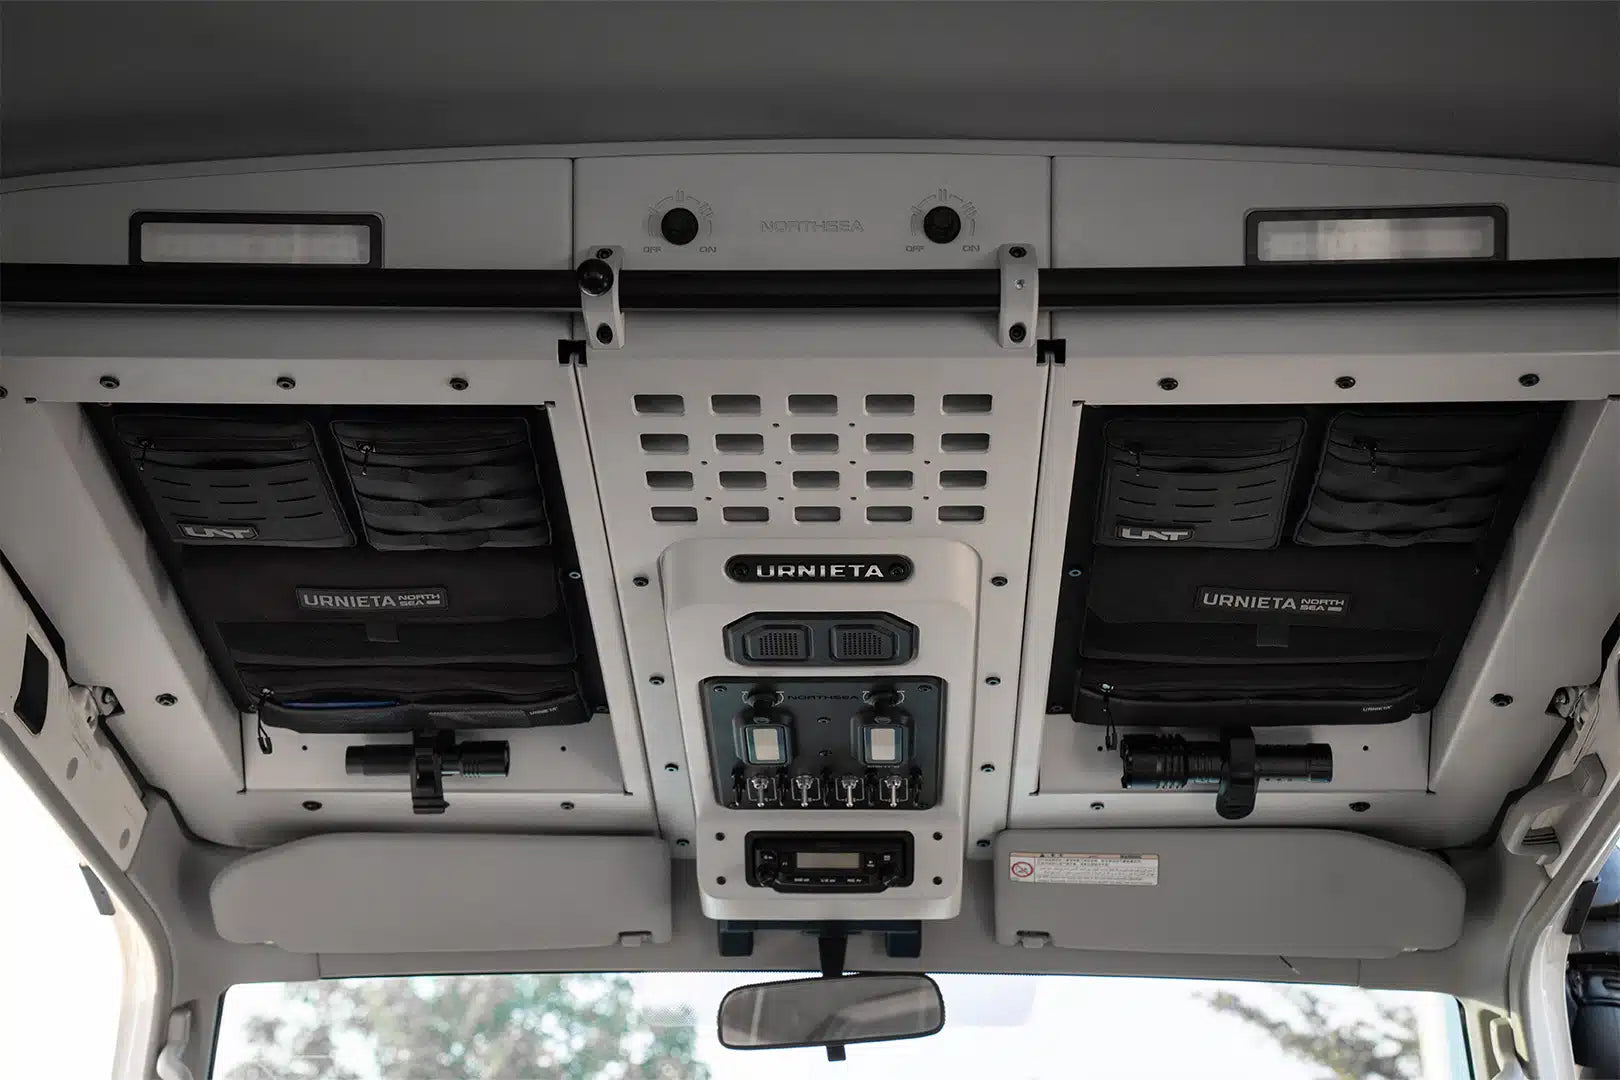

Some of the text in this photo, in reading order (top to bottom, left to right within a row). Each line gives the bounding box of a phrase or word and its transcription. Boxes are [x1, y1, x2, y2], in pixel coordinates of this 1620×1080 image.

[643, 245, 662, 253] OFF
[699, 245, 717, 253] ON
[905, 244, 925, 252] OFF
[962, 244, 980, 252] ON
[756, 564, 884, 577] URNIETA
[303, 593, 441, 608] URNIETA NORTH
[1203, 592, 1345, 610] URNIETA NORTH
